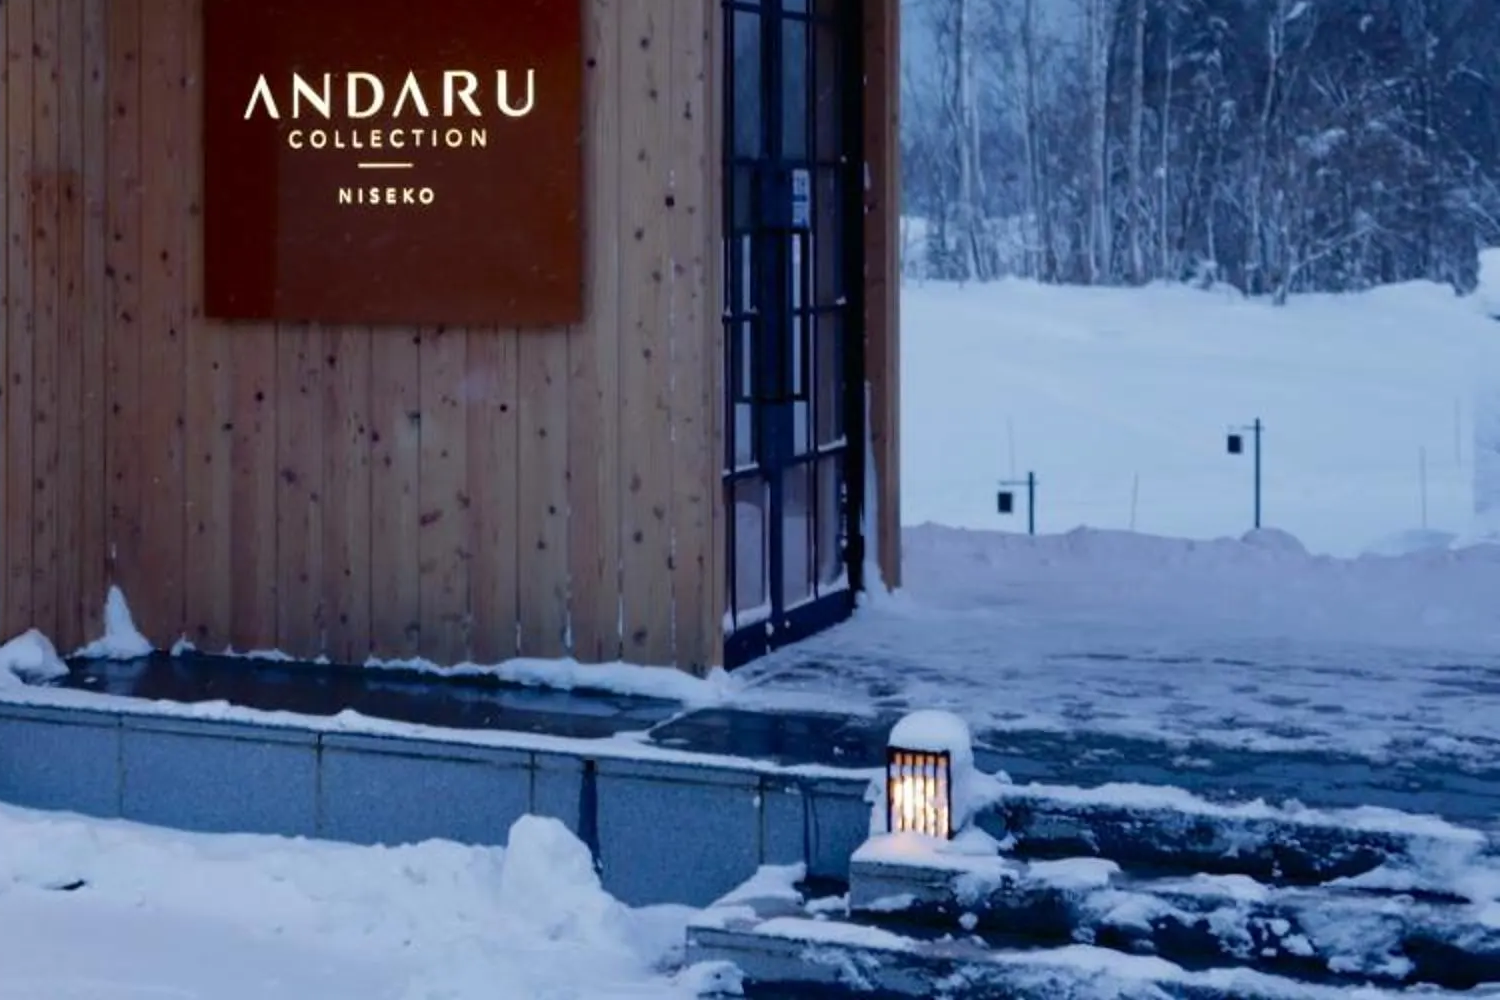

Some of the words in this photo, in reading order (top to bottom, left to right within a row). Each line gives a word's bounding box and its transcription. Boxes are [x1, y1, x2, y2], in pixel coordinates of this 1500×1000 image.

[243, 69, 536, 120] ANDARU
[288, 128, 488, 149] COLLECTION
[339, 187, 435, 205] NISEKO
